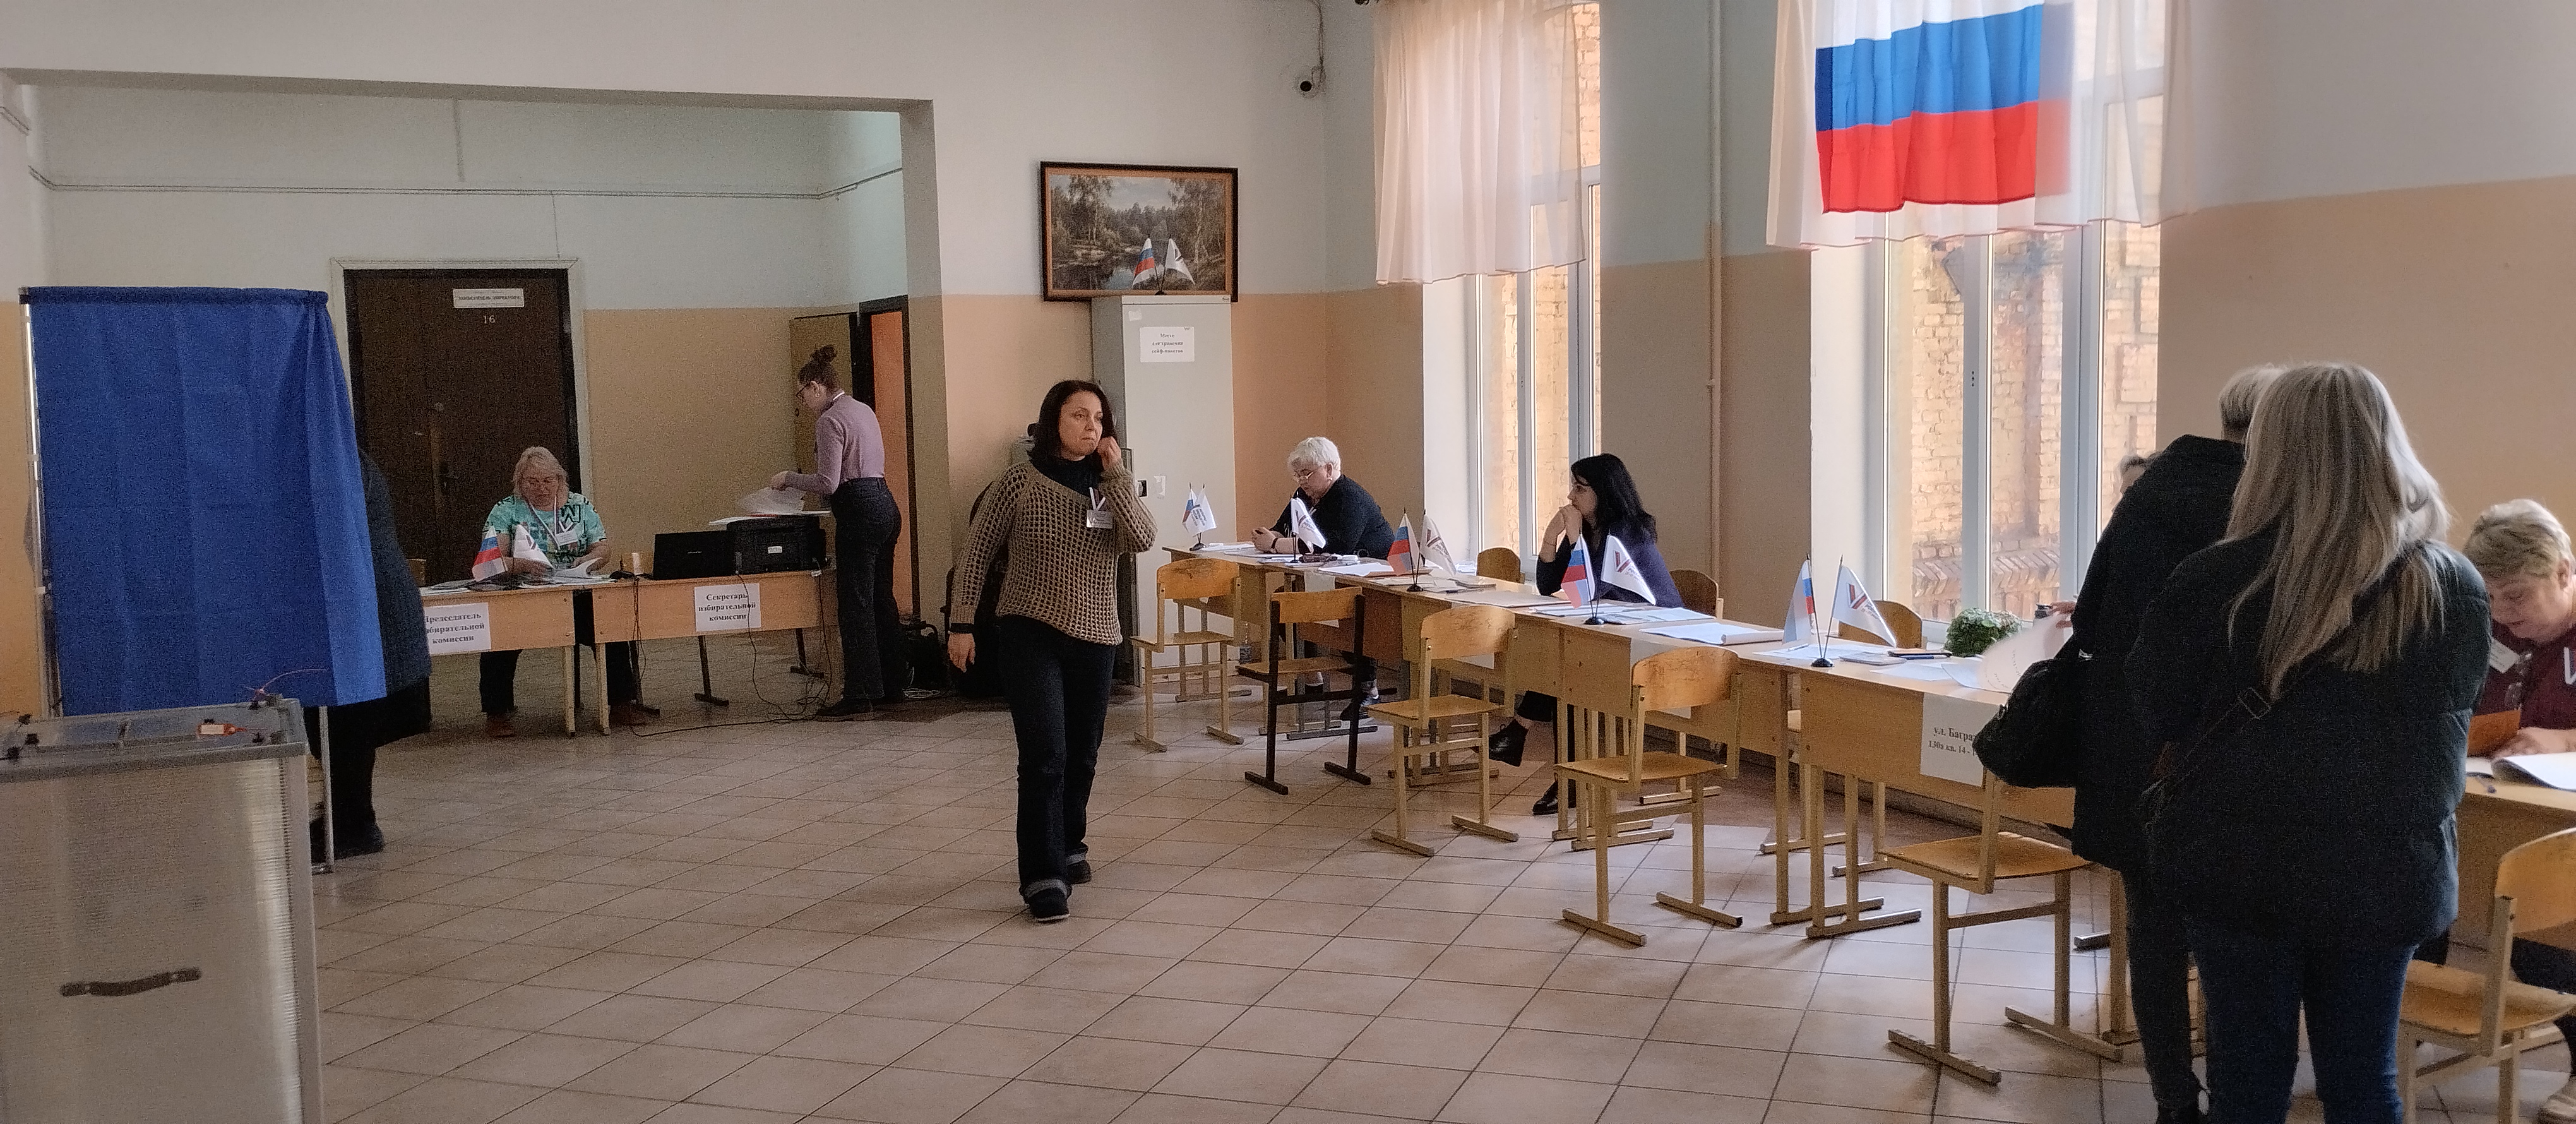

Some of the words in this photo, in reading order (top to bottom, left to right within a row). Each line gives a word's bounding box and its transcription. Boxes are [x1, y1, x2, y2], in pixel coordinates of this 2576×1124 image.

[484, 315, 496, 324] 16
[426, 623, 485, 634] бирательной
[432, 635, 474, 644] комиссии
[1933, 727, 1946, 736] ул.
